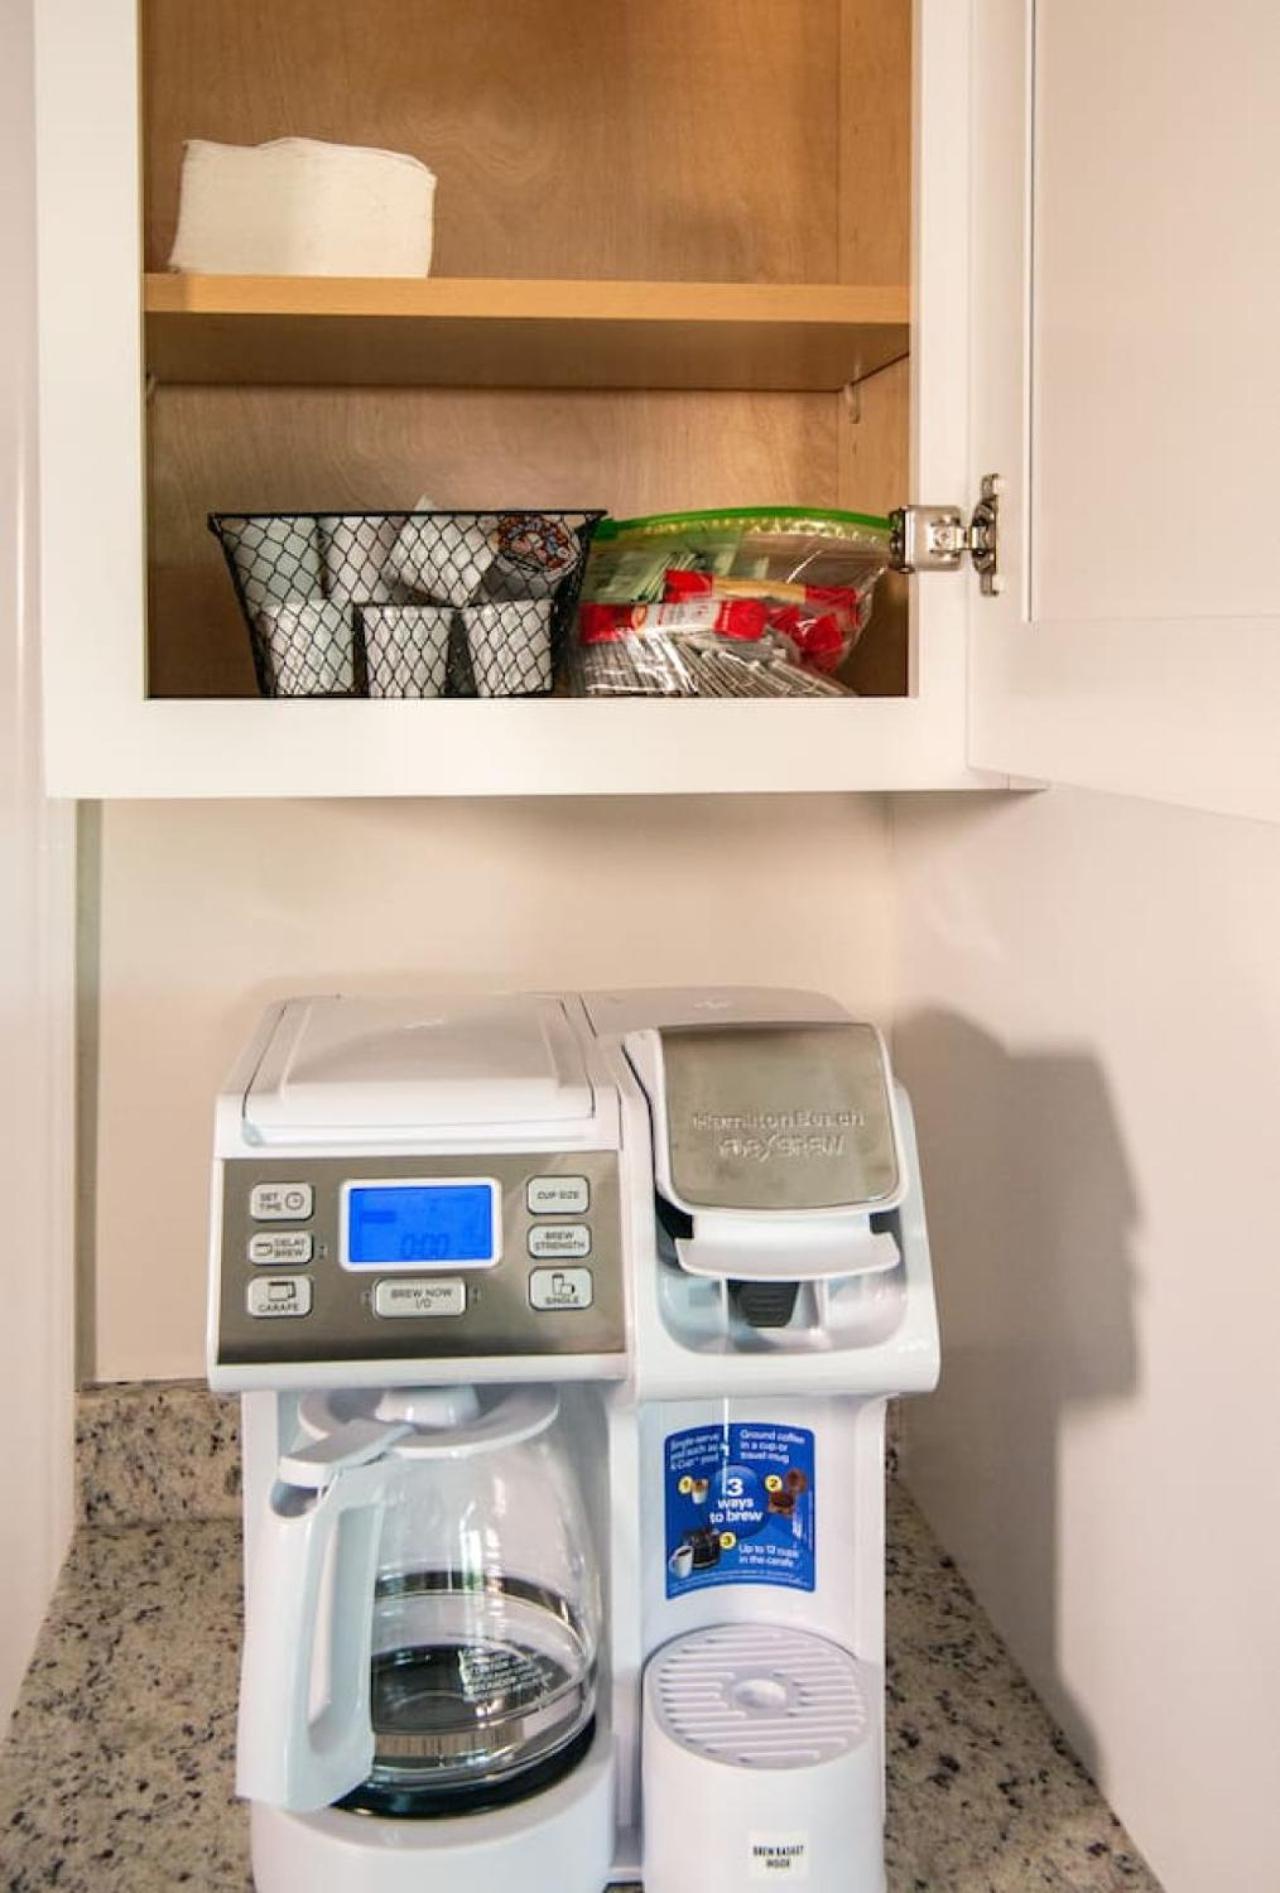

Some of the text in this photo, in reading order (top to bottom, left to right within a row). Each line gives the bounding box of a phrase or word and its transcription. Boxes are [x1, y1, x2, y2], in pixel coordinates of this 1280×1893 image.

[260, 1191, 279, 1201] SET
[537, 1190, 580, 1200] CUP SIZE
[260, 1202, 282, 1211] TIME
[545, 1230, 575, 1240] BREW
[274, 1237, 306, 1248] DELAY
[534, 1240, 586, 1250] STRENGTH
[274, 1247, 303, 1257] BREW
[390, 1287, 453, 1300] BREW NOW
[545, 1296, 580, 1306] SINGLE
[257, 1303, 300, 1313] CARAFE
[740, 1428, 805, 1445] Ground coffee
[726, 1477, 744, 1497] 3
[717, 1498, 755, 1511] ways
[709, 1509, 763, 1524] to brew
